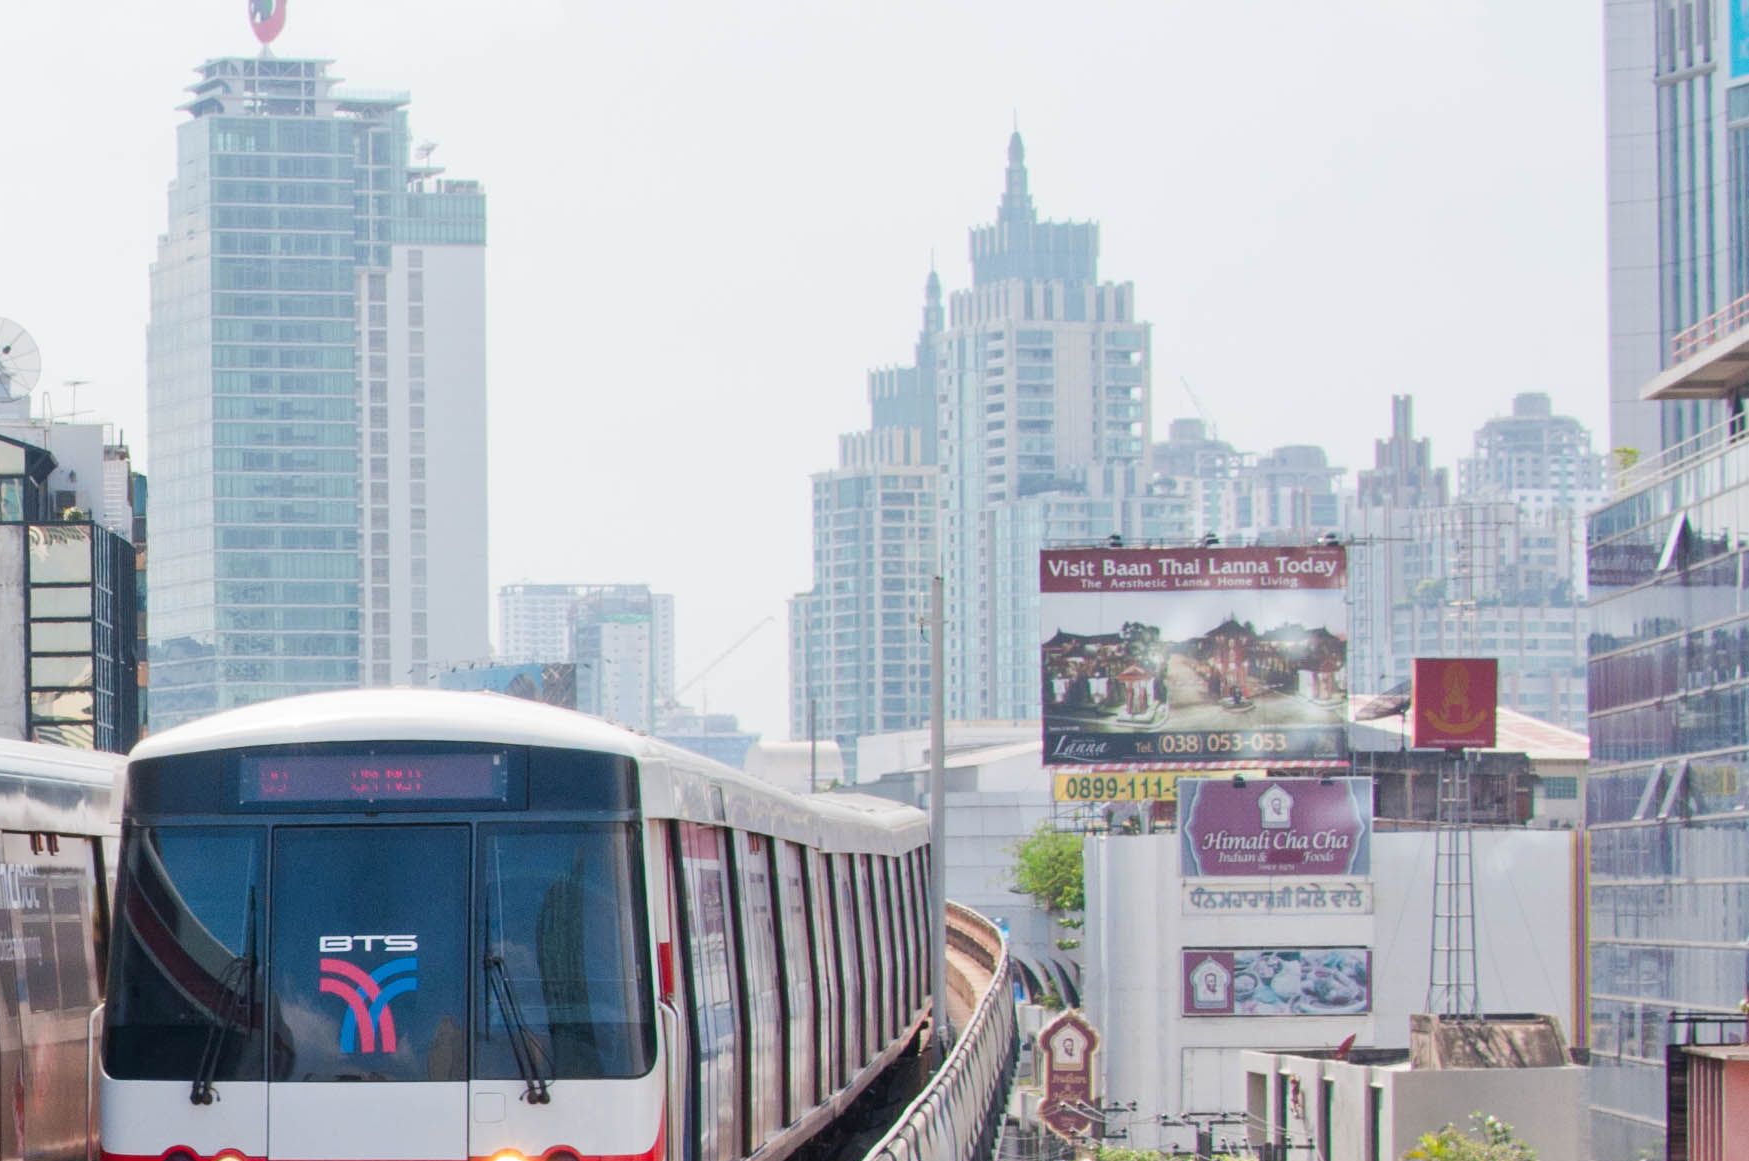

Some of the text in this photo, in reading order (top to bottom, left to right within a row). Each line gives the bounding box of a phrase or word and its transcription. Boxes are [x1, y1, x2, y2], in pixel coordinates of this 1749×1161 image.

[1048, 556, 1338, 577] Visit Baan Thai Lanna Today
[1080, 575, 1298, 589] The Aesthetic Lanna Home Living
[1052, 734, 1108, 757] Lanna
[1158, 734, 1202, 753] (038)
[1207, 733, 1287, 752] 053-053
[1203, 829, 1349, 850] Himali Cha Cha
[1218, 851, 1335, 864] Indian & Foods
[319, 935, 418, 952] BTS
